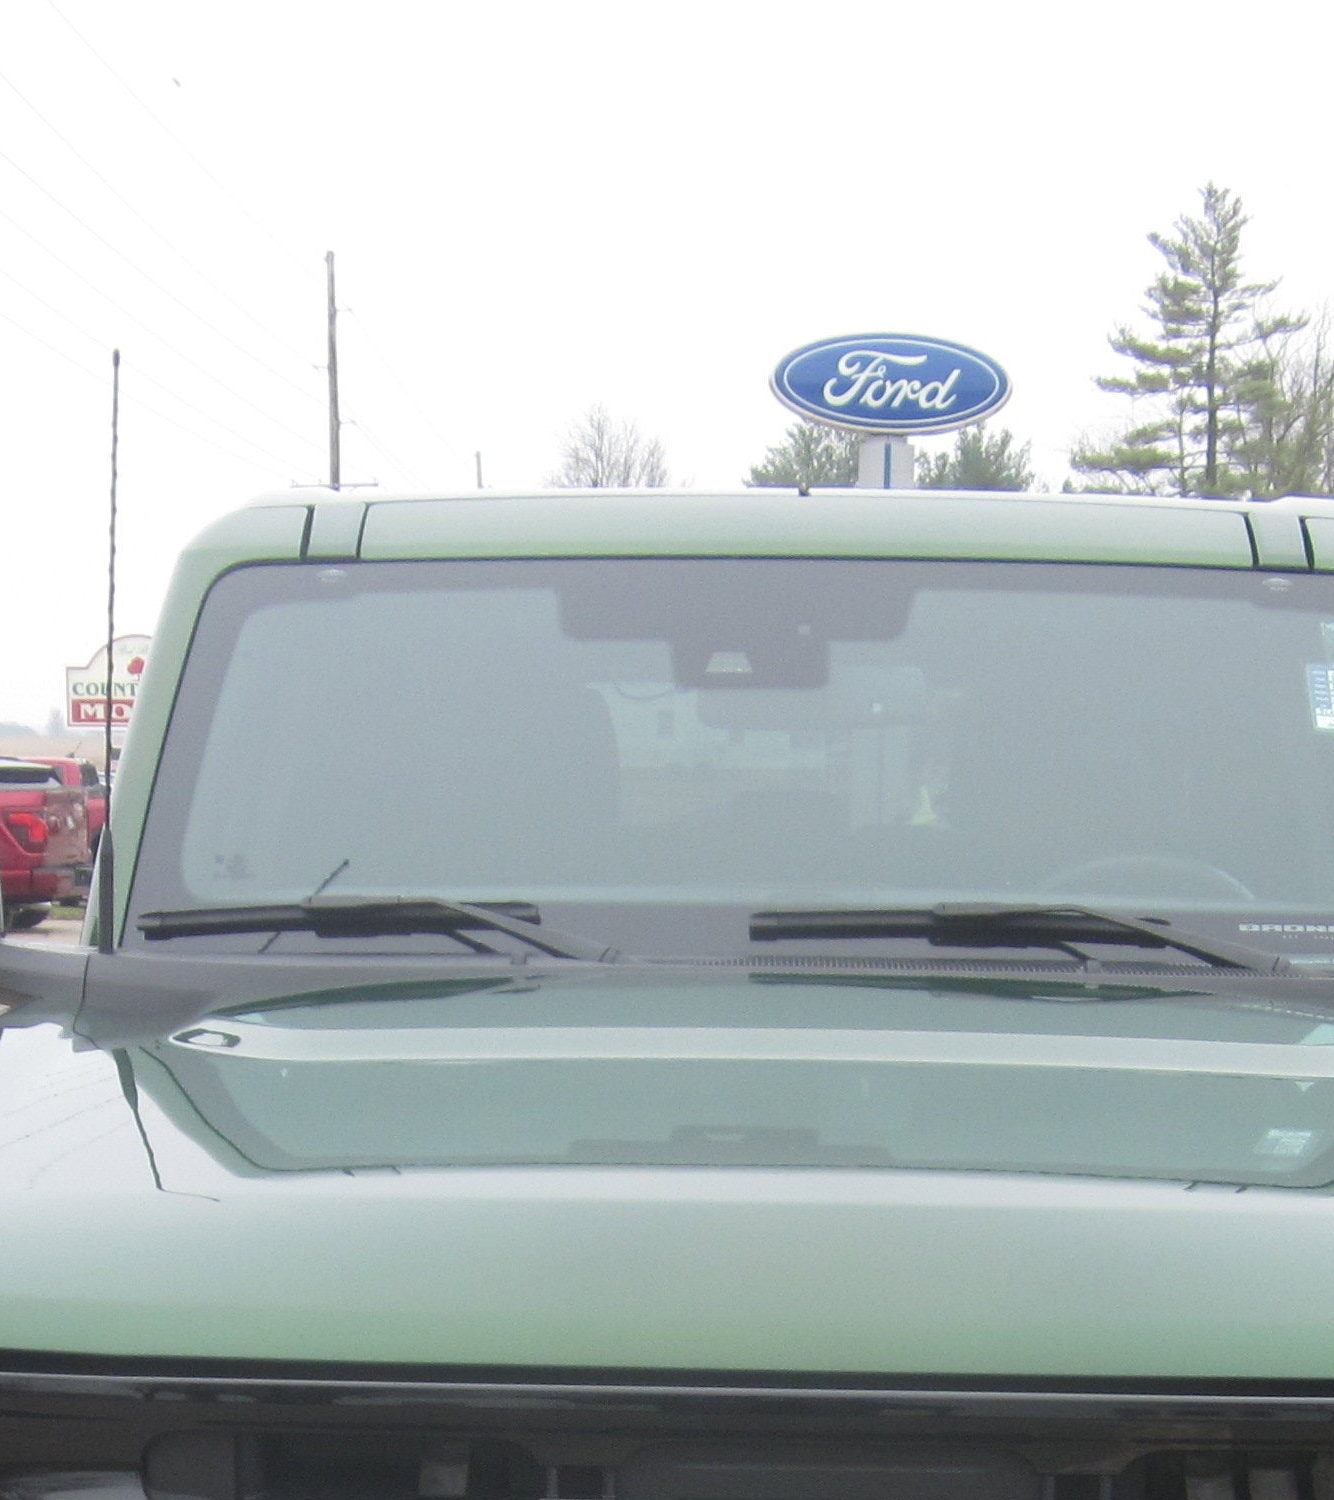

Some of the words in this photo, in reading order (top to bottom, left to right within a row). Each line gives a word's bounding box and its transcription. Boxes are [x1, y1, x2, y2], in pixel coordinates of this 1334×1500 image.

[822, 349, 962, 410] Ford
[72, 681, 138, 697] COUNT
[80, 702, 132, 720] MO
